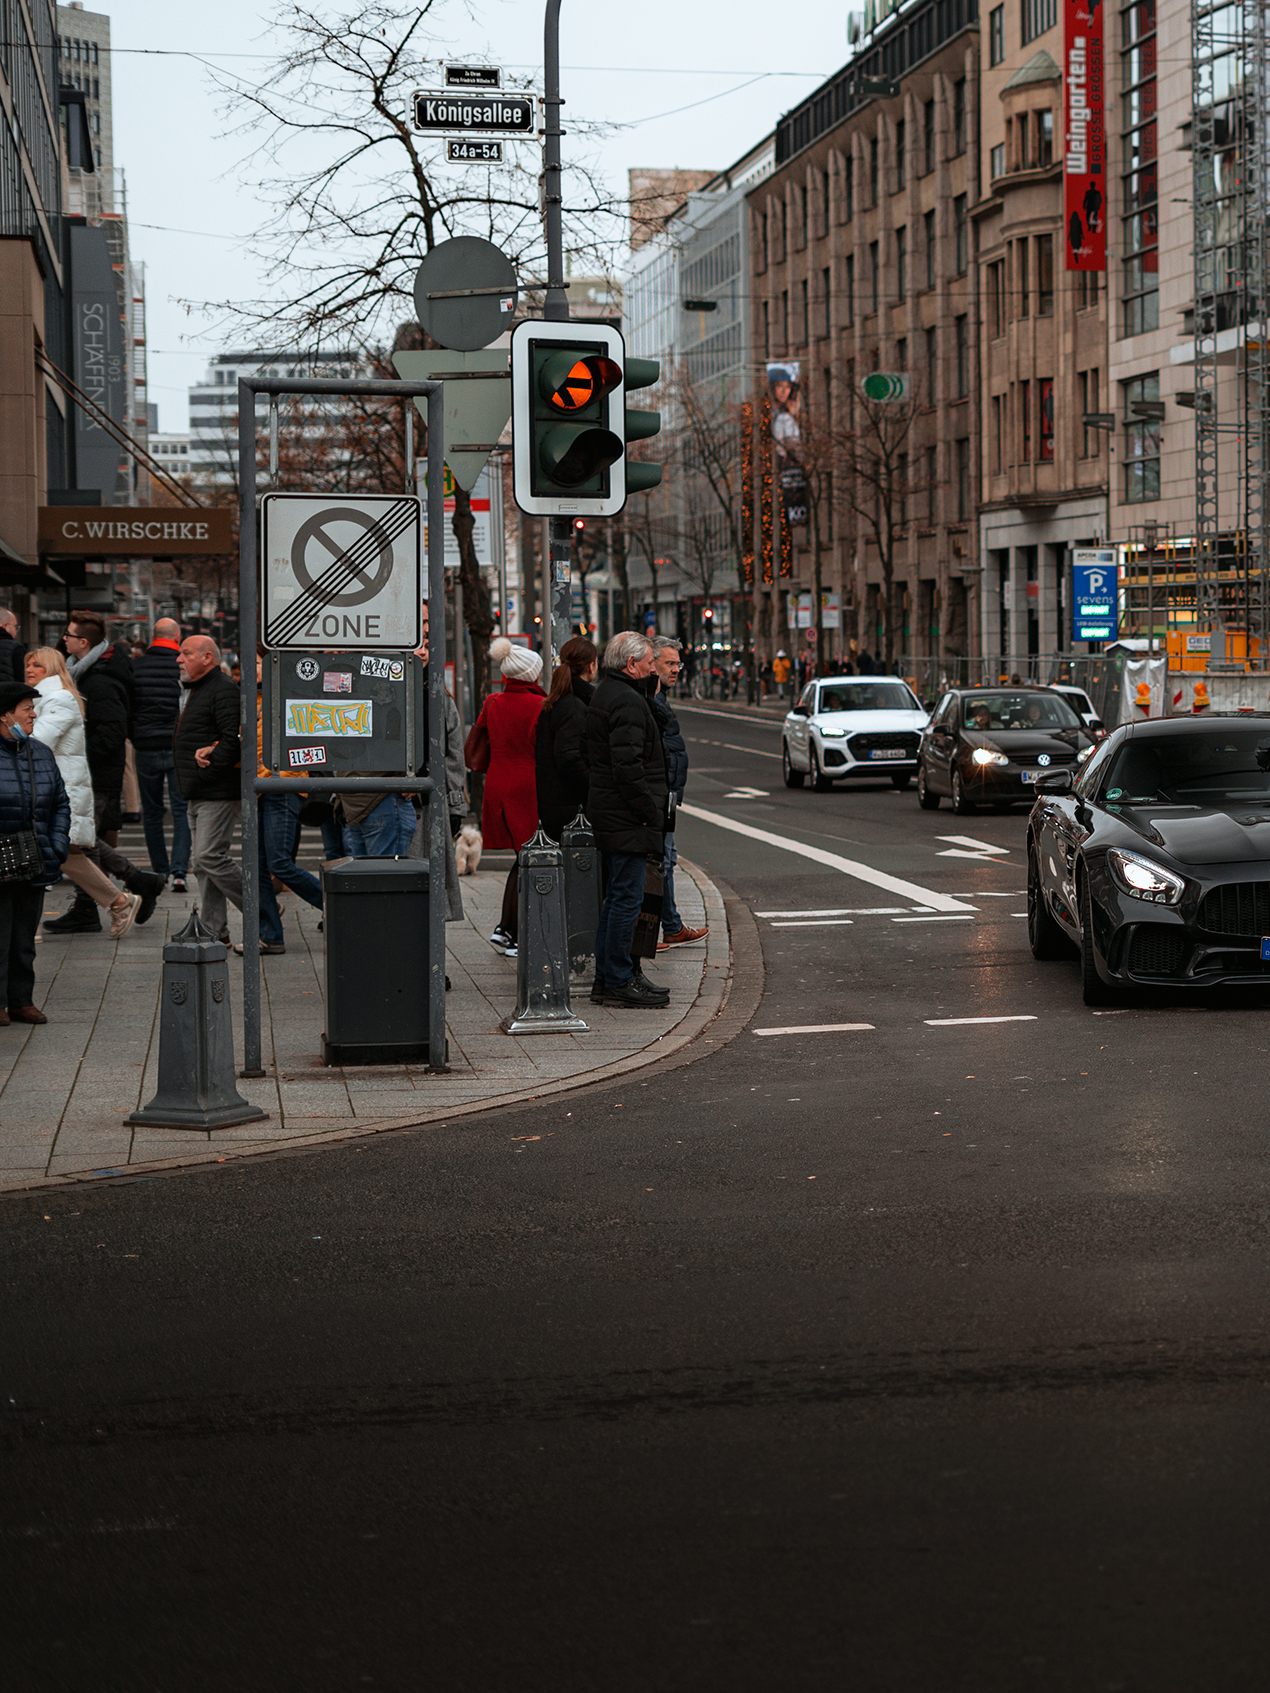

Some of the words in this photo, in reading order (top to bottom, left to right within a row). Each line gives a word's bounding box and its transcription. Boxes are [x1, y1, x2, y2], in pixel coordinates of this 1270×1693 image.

[426, 100, 522, 126] Königsallee
[1091, 108, 1101, 162] GROSSE
[452, 144, 498, 158] 34a-54
[107, 354, 121, 383] 1903
[1089, 574, 1103, 594] P
[1077, 596, 1114, 604] sevens
[304, 614, 381, 638] ZONE
